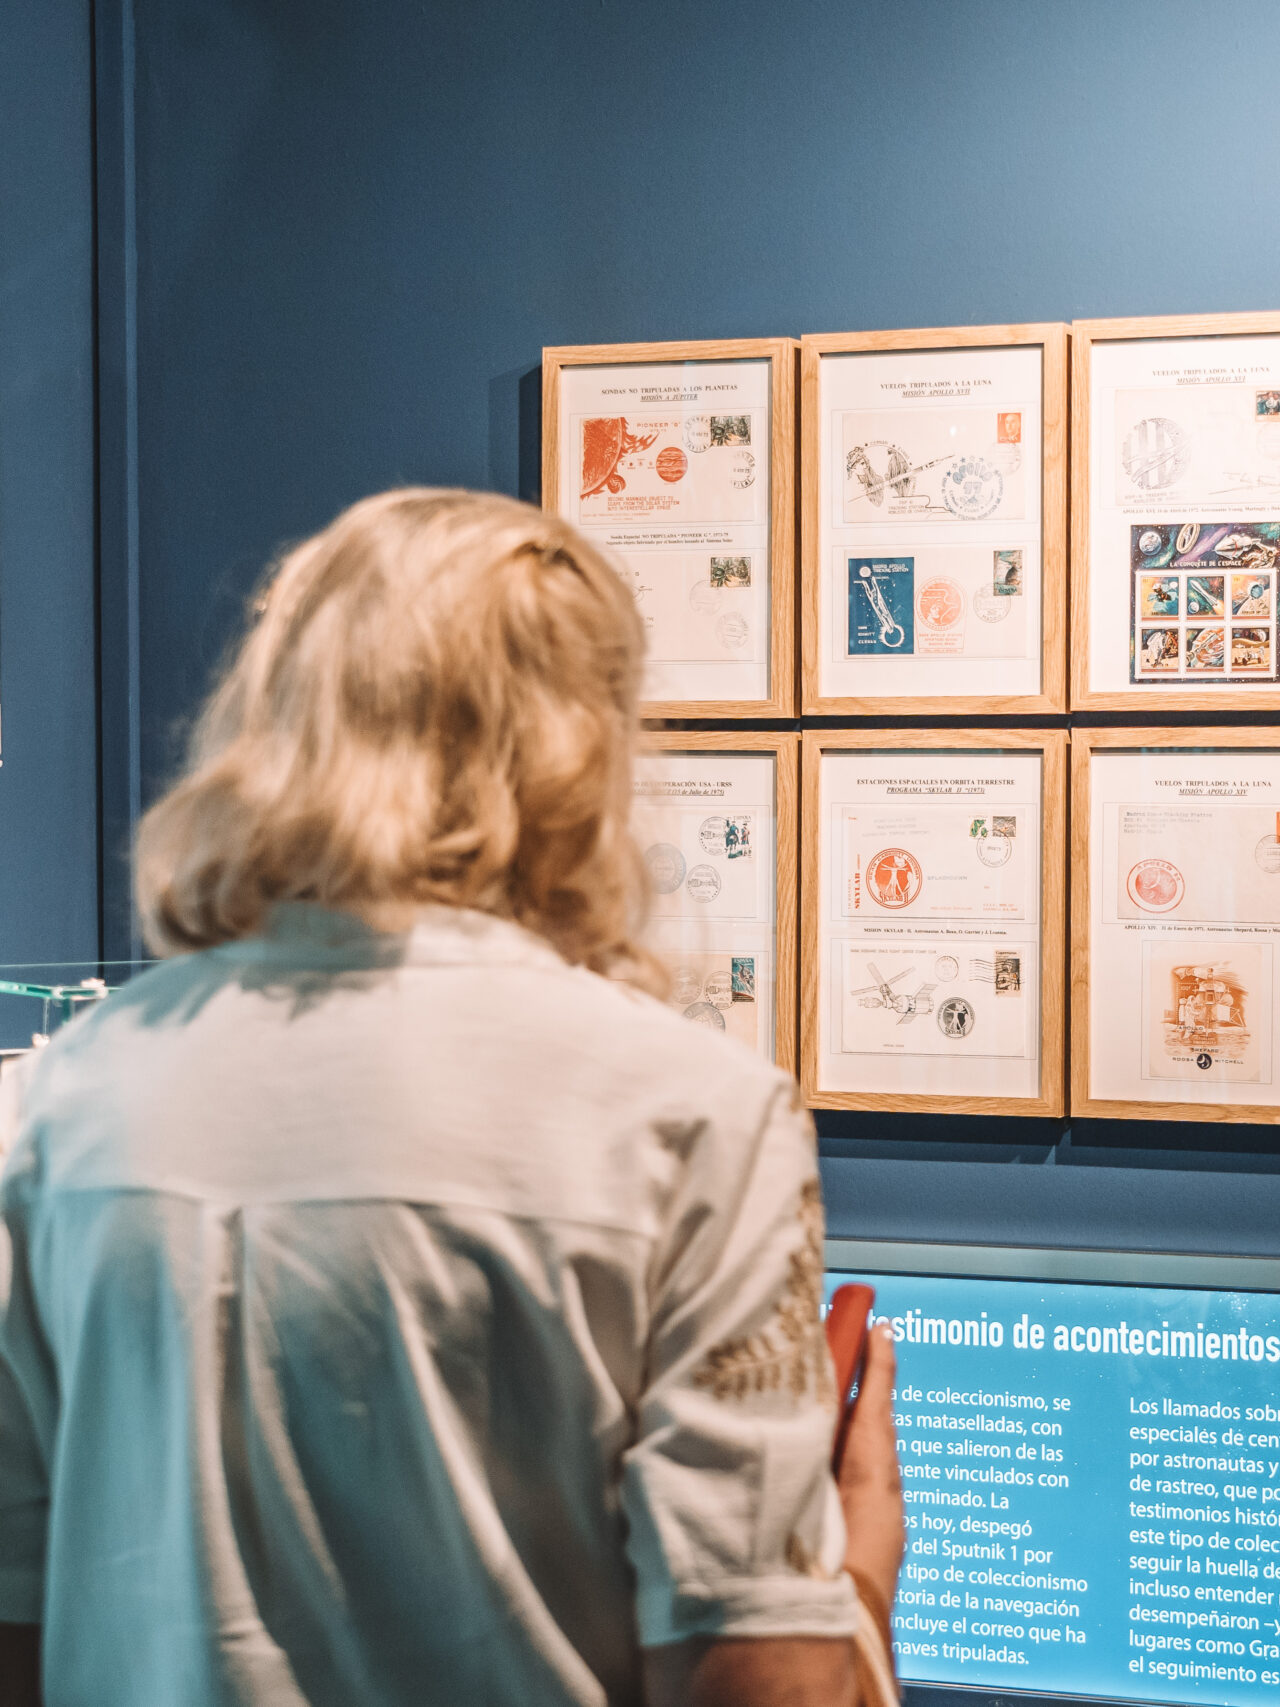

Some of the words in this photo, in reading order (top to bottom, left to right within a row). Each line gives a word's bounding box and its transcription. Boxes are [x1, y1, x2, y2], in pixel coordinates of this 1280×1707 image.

[1012, 1316, 1045, 1350] de
[1053, 1321, 1280, 1362] acontecimientos
[1129, 1396, 1159, 1414] Los
[1162, 1397, 1241, 1420] llamados
[1129, 1425, 1217, 1444] especiales
[1221, 1427, 1244, 1446] de
[910, 1439, 943, 1456] que
[946, 1438, 1011, 1458] salieron
[1015, 1441, 1037, 1460] de
[1041, 1443, 1063, 1462] las
[1129, 1452, 1160, 1469] por
[1162, 1452, 1265, 1473] astronautas
[1267, 1461, 1279, 1478] y
[1129, 1473, 1152, 1492] de
[1155, 1478, 1219, 1499] rastreo,
[1223, 1484, 1257, 1501] que
[1128, 1500, 1231, 1523] testimonios
[911, 1536, 937, 1555] del
[941, 1539, 1005, 1560] Sputnik
[1010, 1544, 1017, 1561] 1
[1023, 1549, 1053, 1566] por
[1128, 1528, 1165, 1545] este
[1168, 1528, 1204, 1550] tipo
[1207, 1531, 1231, 1549] de
[905, 1562, 940, 1583] tipo
[943, 1564, 965, 1583] de
[967, 1567, 1088, 1592] coleccionismo
[1129, 1554, 1183, 1574] seguir
[1186, 1554, 1201, 1573] la
[1205, 1556, 1258, 1579] huella
[1129, 1577, 1191, 1599] incluso
[1193, 1585, 1275, 1605] entender
[951, 1616, 967, 1634] el
[970, 1621, 1025, 1638] correo
[1027, 1626, 1061, 1644] que
[1065, 1624, 1086, 1643] ha
[1128, 1603, 1259, 1630] desempeñaron
[941, 1642, 1029, 1664] tripuladas.
[1129, 1628, 1192, 1652] lugares
[1195, 1638, 1245, 1655] como
[1128, 1655, 1144, 1673] el
[1147, 1660, 1257, 1682] seguimiento
